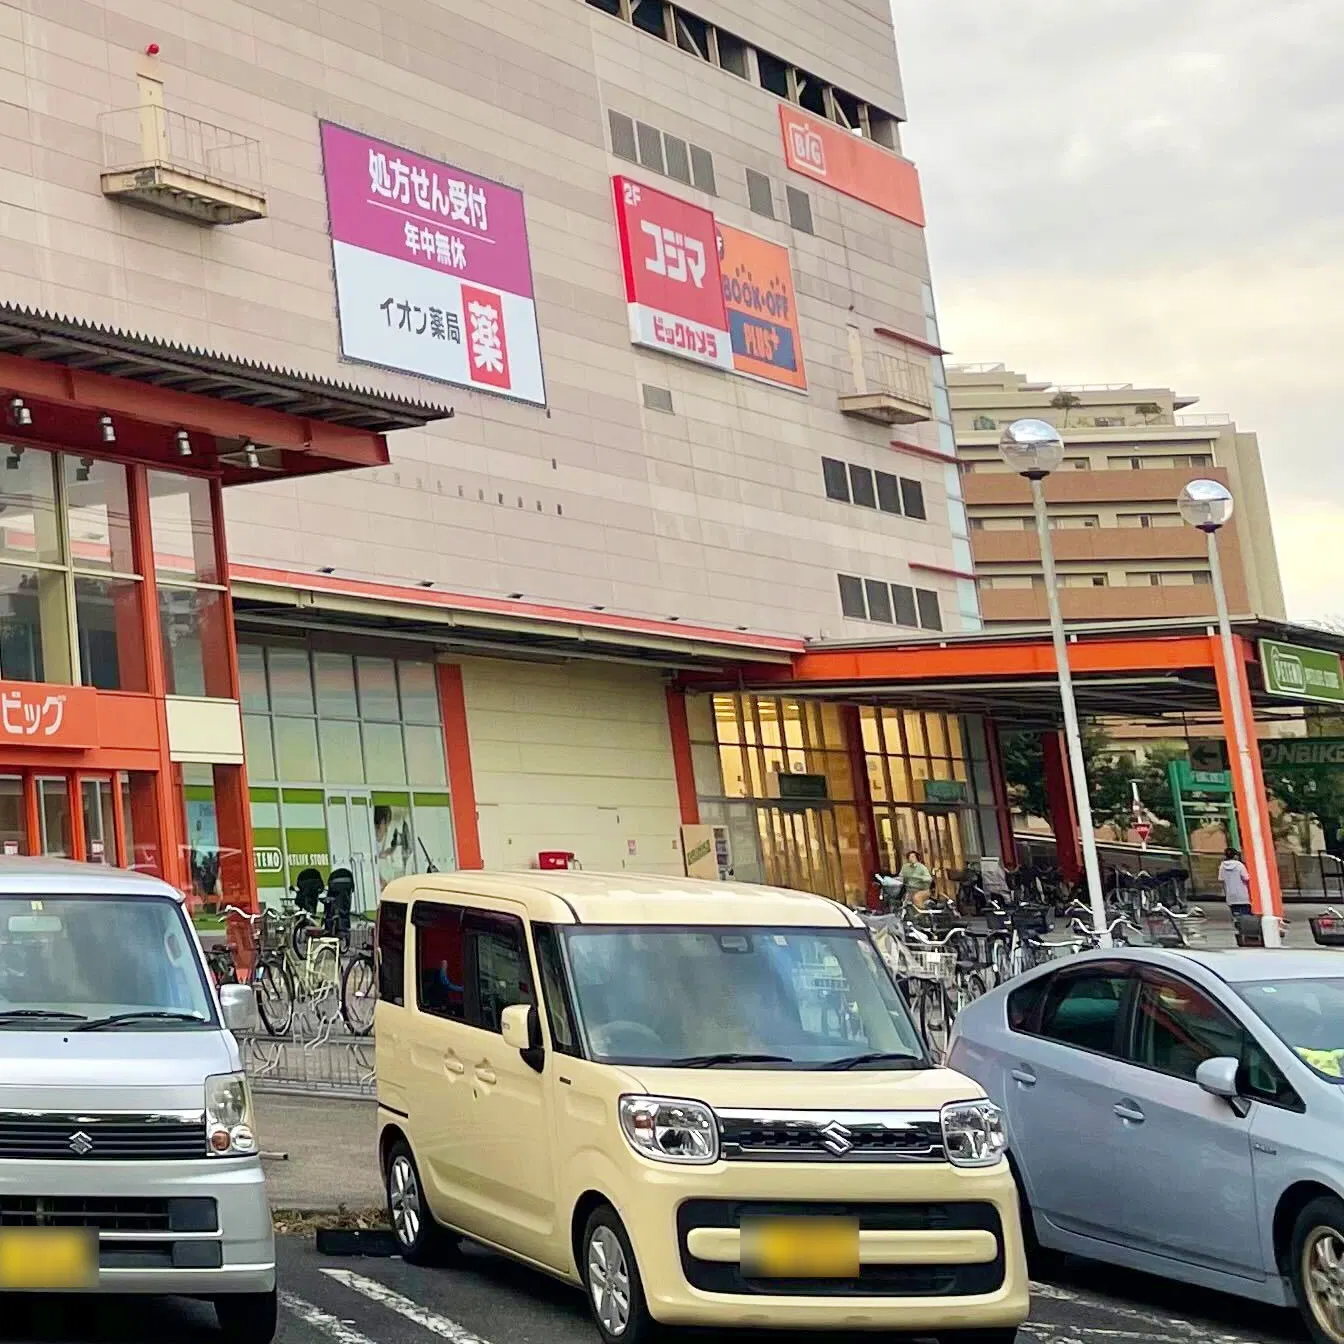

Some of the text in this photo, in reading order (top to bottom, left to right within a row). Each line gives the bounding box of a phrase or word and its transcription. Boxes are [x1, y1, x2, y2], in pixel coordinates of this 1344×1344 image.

[368, 148, 488, 231] 処方せん受付
[623, 182, 641, 206] 2F
[404, 221, 467, 271] 年中無休
[640, 219, 707, 289] コジマ
[379, 296, 461, 345] イオン薬局
[468, 300, 505, 374] 薬
[653, 315, 718, 359] ビックカメラ
